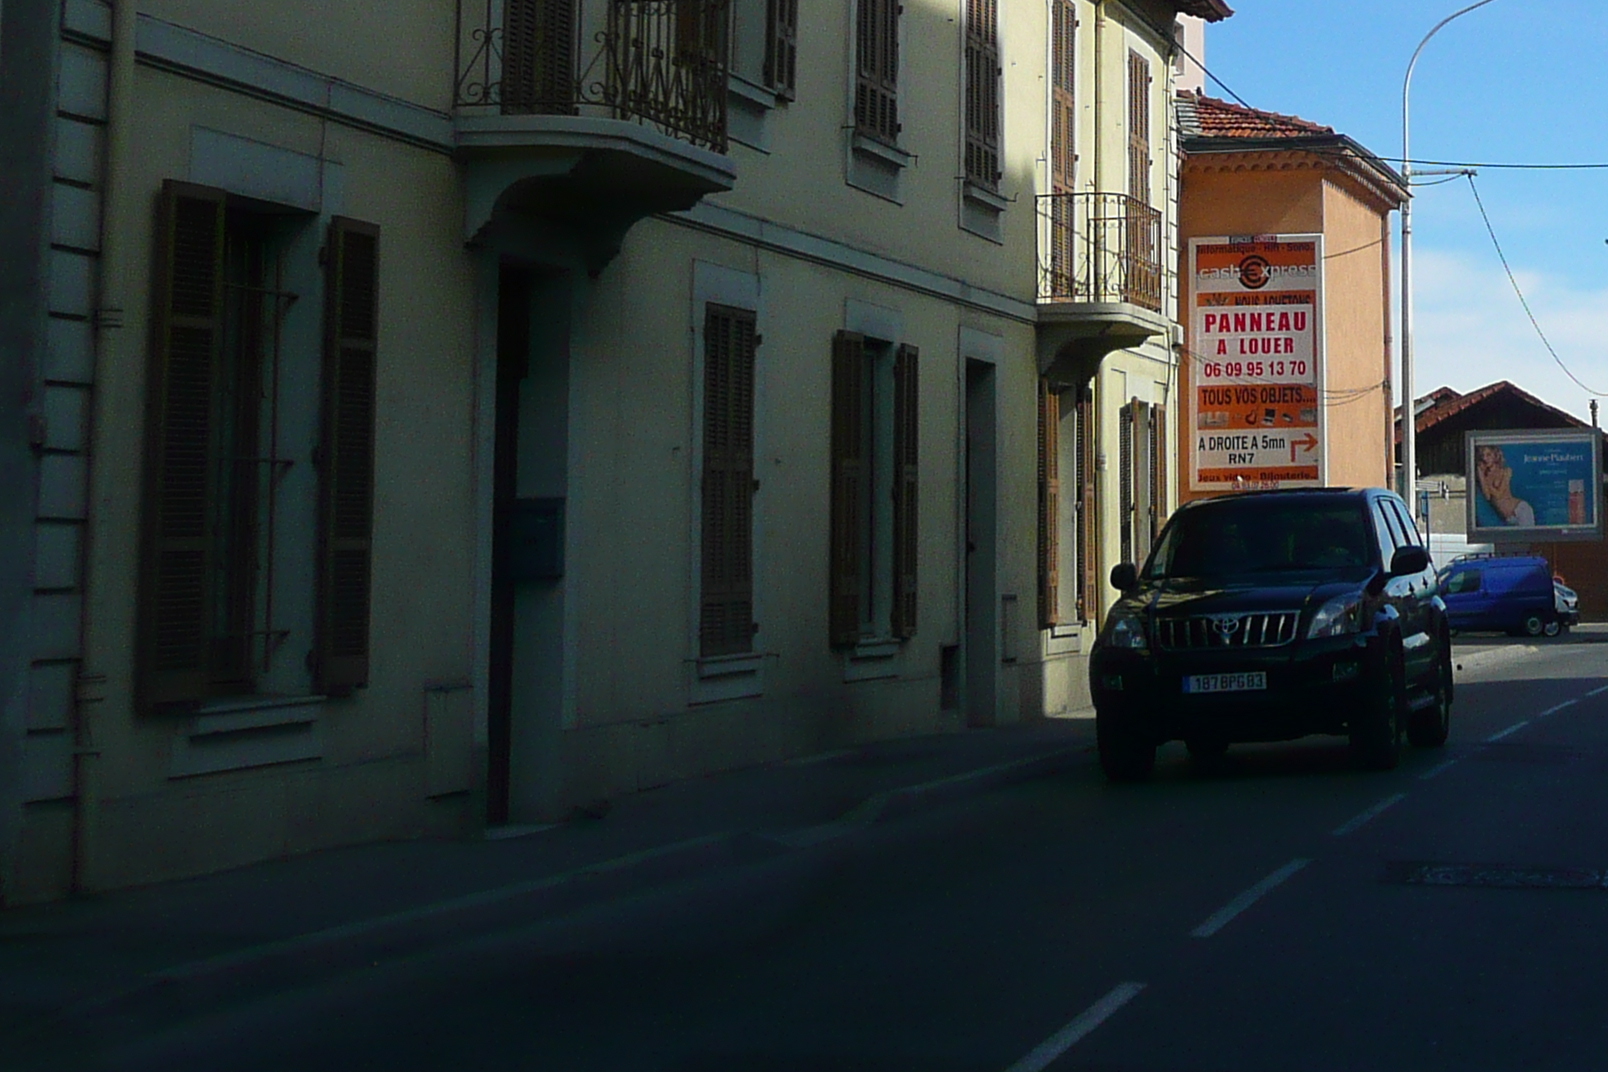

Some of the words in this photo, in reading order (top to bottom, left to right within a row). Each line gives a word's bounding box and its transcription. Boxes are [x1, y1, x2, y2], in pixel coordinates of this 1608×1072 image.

[1201, 264, 1240, 279] cash
[1205, 311, 1306, 333] PANNEAU
[1217, 339, 1227, 355] A
[1240, 337, 1294, 354] LOUER
[1204, 362, 1221, 377] 06
[1225, 362, 1242, 377] 09
[1246, 361, 1263, 376] 95
[1268, 361, 1285, 376] 13
[1289, 360, 1306, 376] 70
[1202, 389, 1231, 405] TOUS
[1234, 388, 1257, 404] VOS
[1199, 438, 1206, 451] A
[1209, 436, 1249, 450] DROITE
[1251, 436, 1259, 450] A
[1262, 435, 1285, 449] 5mn
[1229, 453, 1255, 464] RN7
